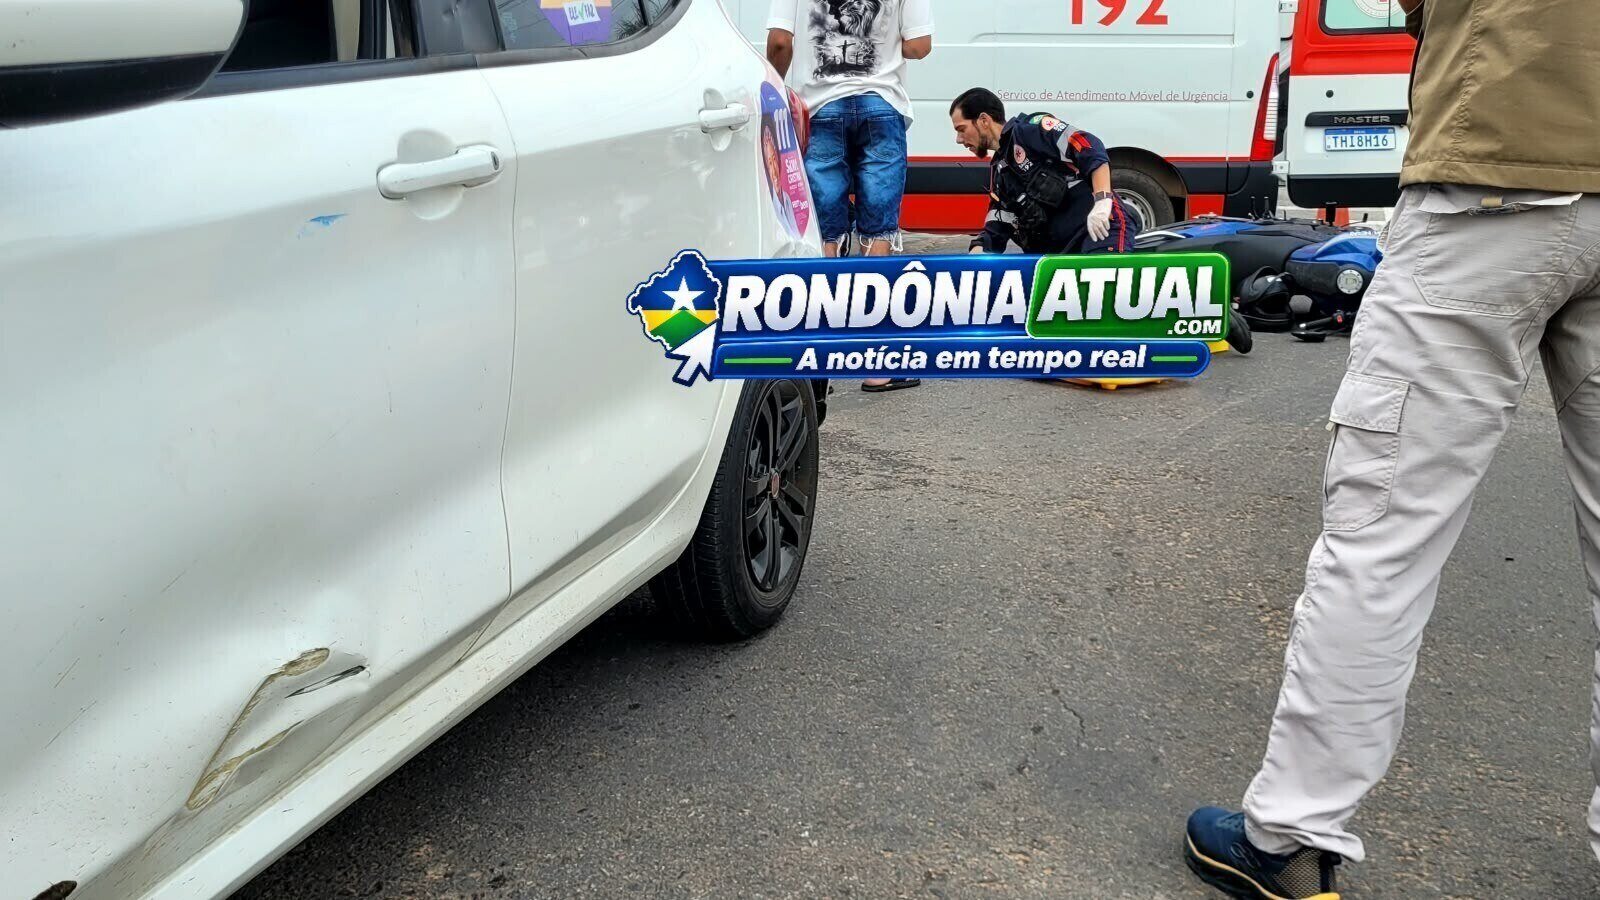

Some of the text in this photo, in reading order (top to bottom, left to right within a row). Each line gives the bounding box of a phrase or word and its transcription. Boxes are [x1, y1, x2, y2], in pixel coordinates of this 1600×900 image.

[998, 89, 1228, 104] Serviço de Atendimento Móvel de Urgência
[1333, 115, 1391, 124] MASTER
[1332, 135, 1388, 148] THI8H16
